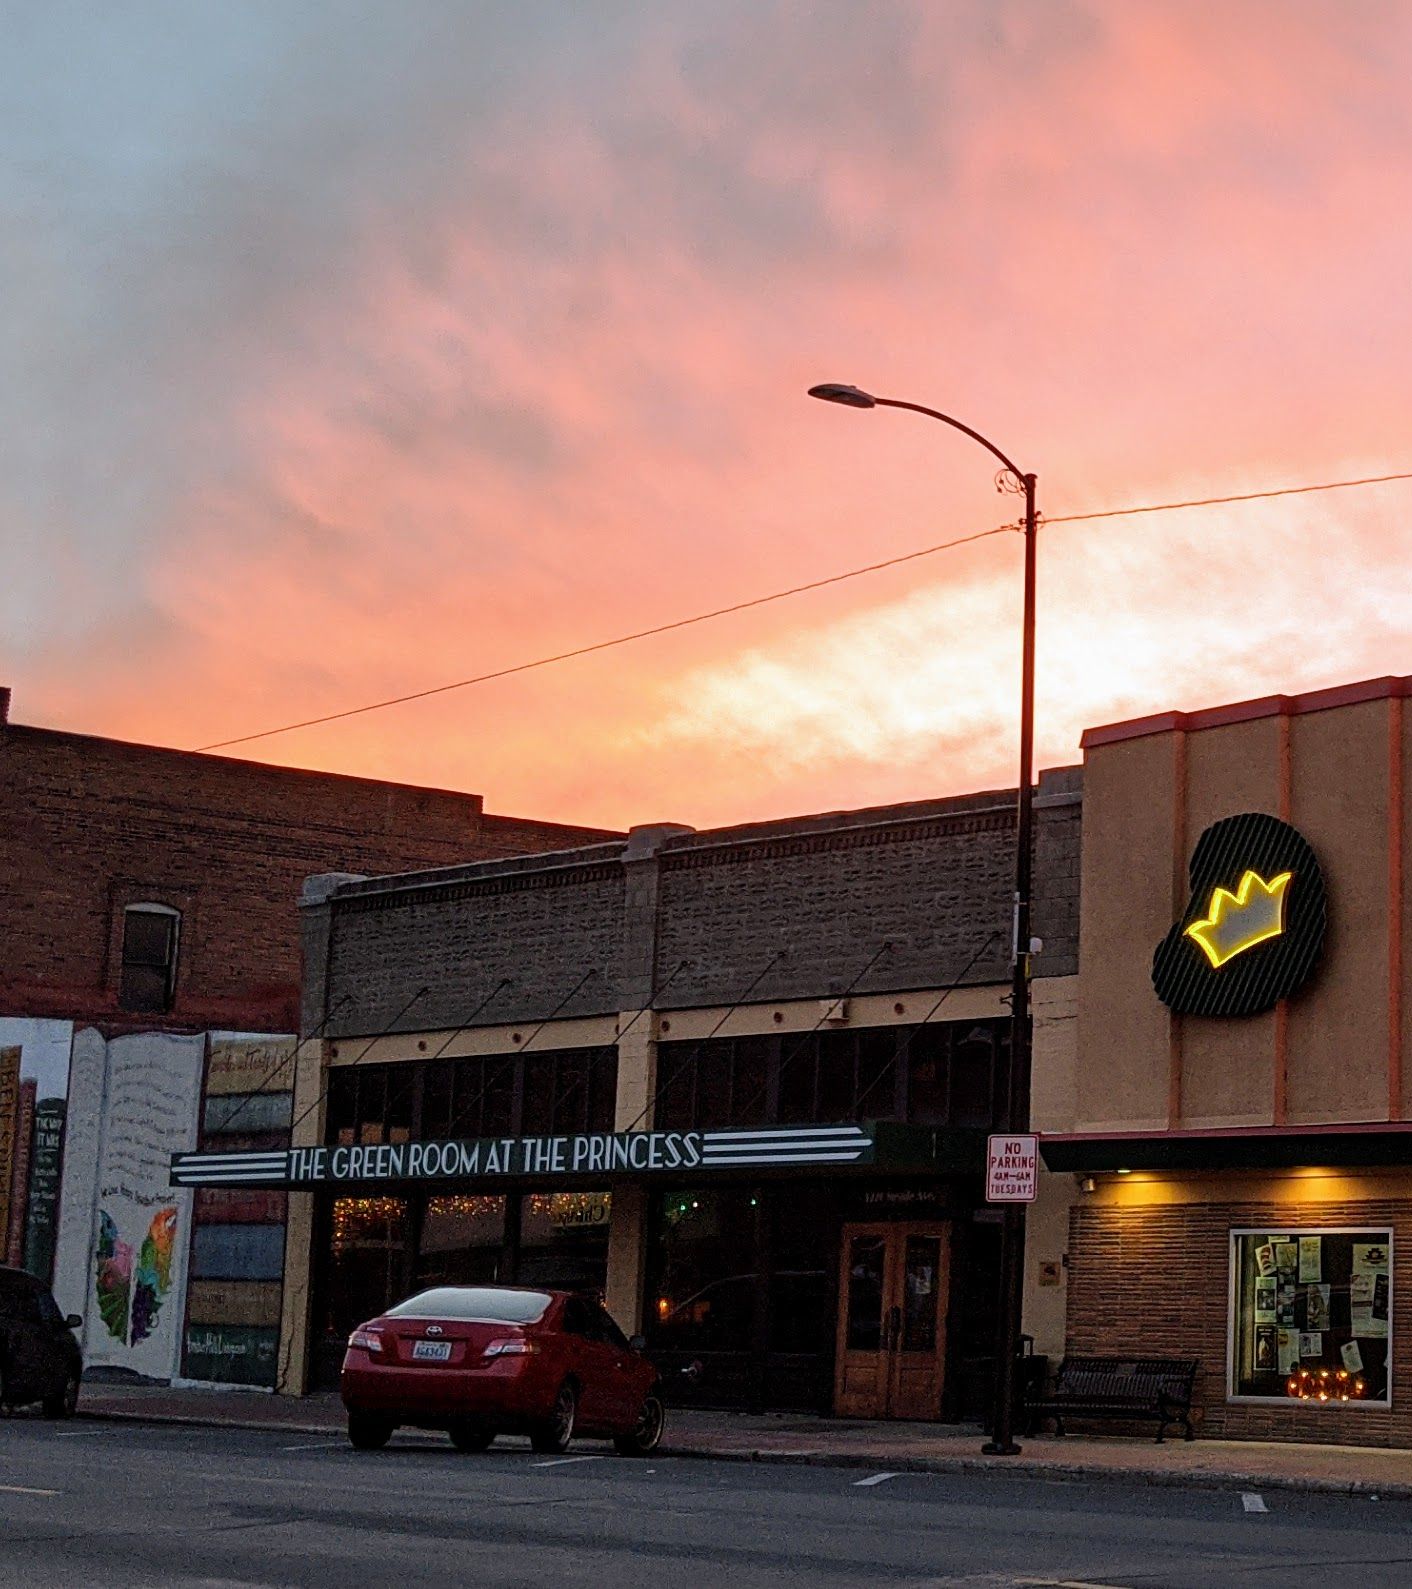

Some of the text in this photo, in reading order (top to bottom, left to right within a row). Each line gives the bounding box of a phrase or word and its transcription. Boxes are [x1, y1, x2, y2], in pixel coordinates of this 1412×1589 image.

[1004, 1142, 1021, 1154] NO
[289, 1132, 700, 1180] THE GREEN ROOM AT THE PRINCESS
[991, 1156, 1034, 1168] PARKING
[991, 1184, 1033, 1194] TUESDAYS
